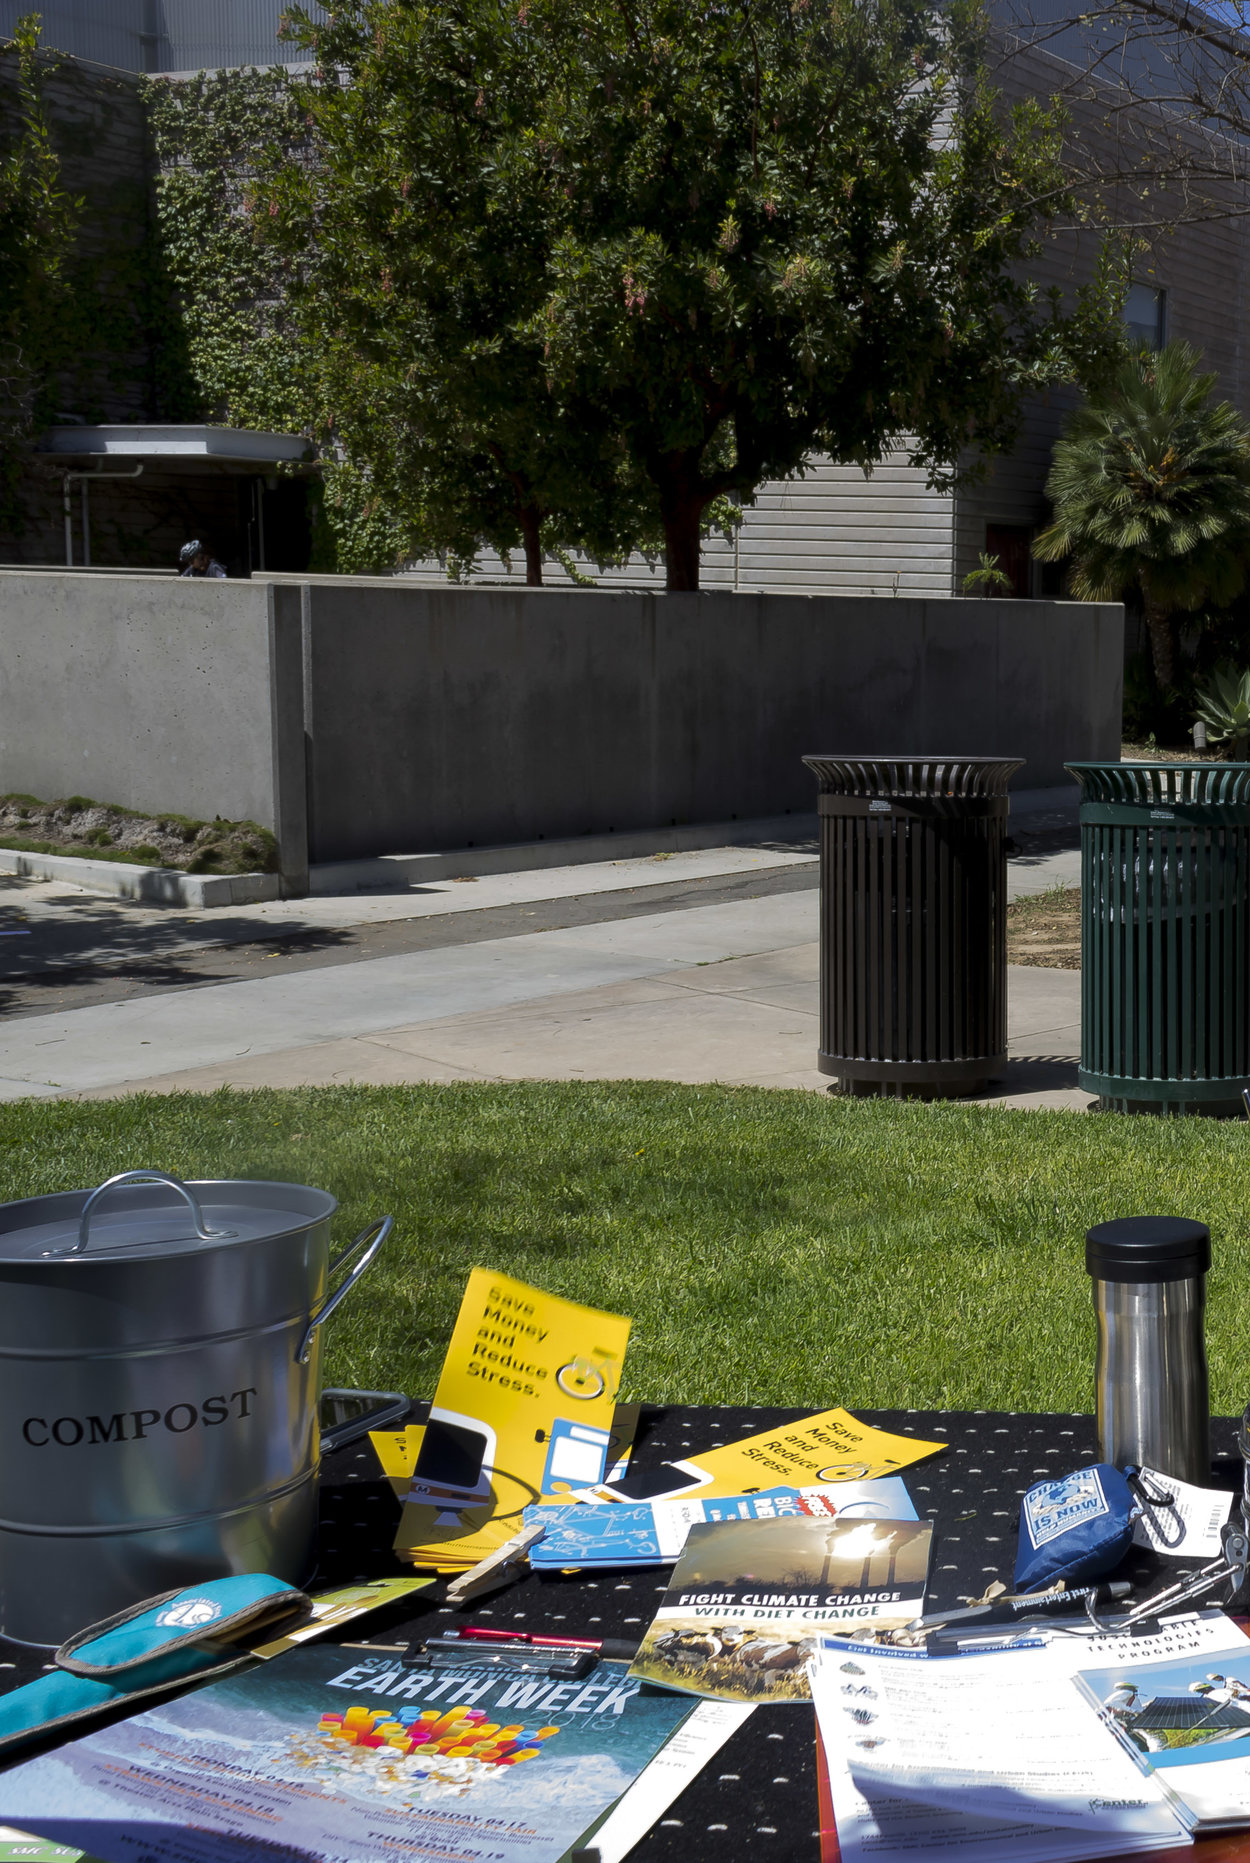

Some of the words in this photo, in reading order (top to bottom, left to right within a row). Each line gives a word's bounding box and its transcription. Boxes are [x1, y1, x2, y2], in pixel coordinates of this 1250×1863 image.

[489, 1286, 536, 1316] Save
[483, 1306, 549, 1343] Money
[477, 1327, 516, 1349] and
[472, 1343, 549, 1380] Reduce
[466, 1362, 540, 1398] Stress.
[22, 1387, 258, 1447] COMPOST
[784, 1435, 819, 1452] and
[806, 1428, 858, 1454] Money
[826, 1422, 863, 1443] Save
[742, 1448, 792, 1476] Stress.
[763, 1441, 819, 1470] Reduce
[1029, 1471, 1093, 1503] CHAGE
[1034, 1517, 1053, 1532] IS
[1056, 1497, 1099, 1517] NOW
[679, 1593, 736, 1606] FIGHT
[741, 1593, 818, 1607] CLIMATE
[825, 1592, 901, 1605] CHANGE
[695, 1607, 746, 1617] WITH
[753, 1608, 795, 1619] DIET
[802, 1605, 880, 1619] CHANGE
[1012, 1590, 1071, 1611] Entertainment
[1087, 1628, 1215, 1652] TECHNOLOGIES
[1118, 1641, 1200, 1659] PROGRAM
[325, 1666, 489, 1704] EARTH
[495, 1681, 640, 1714] WEEK
[520, 1710, 621, 1731] 2018
[192, 1754, 266, 1777] MONDAY
[129, 1764, 232, 1800] WEDNESDAY
[273, 1782, 348, 1805] STUDENTS
[203, 1796, 284, 1823] SCREENING
[385, 1808, 503, 1832] SUSTAINABILITY
[505, 1826, 538, 1836] FAIR
[408, 1806, 483, 1823] TUESDAY
[486, 1817, 529, 1829] 04.17
[367, 1830, 462, 1853] THURSDAY
[383, 1840, 476, 1862] WORKSHOPS
